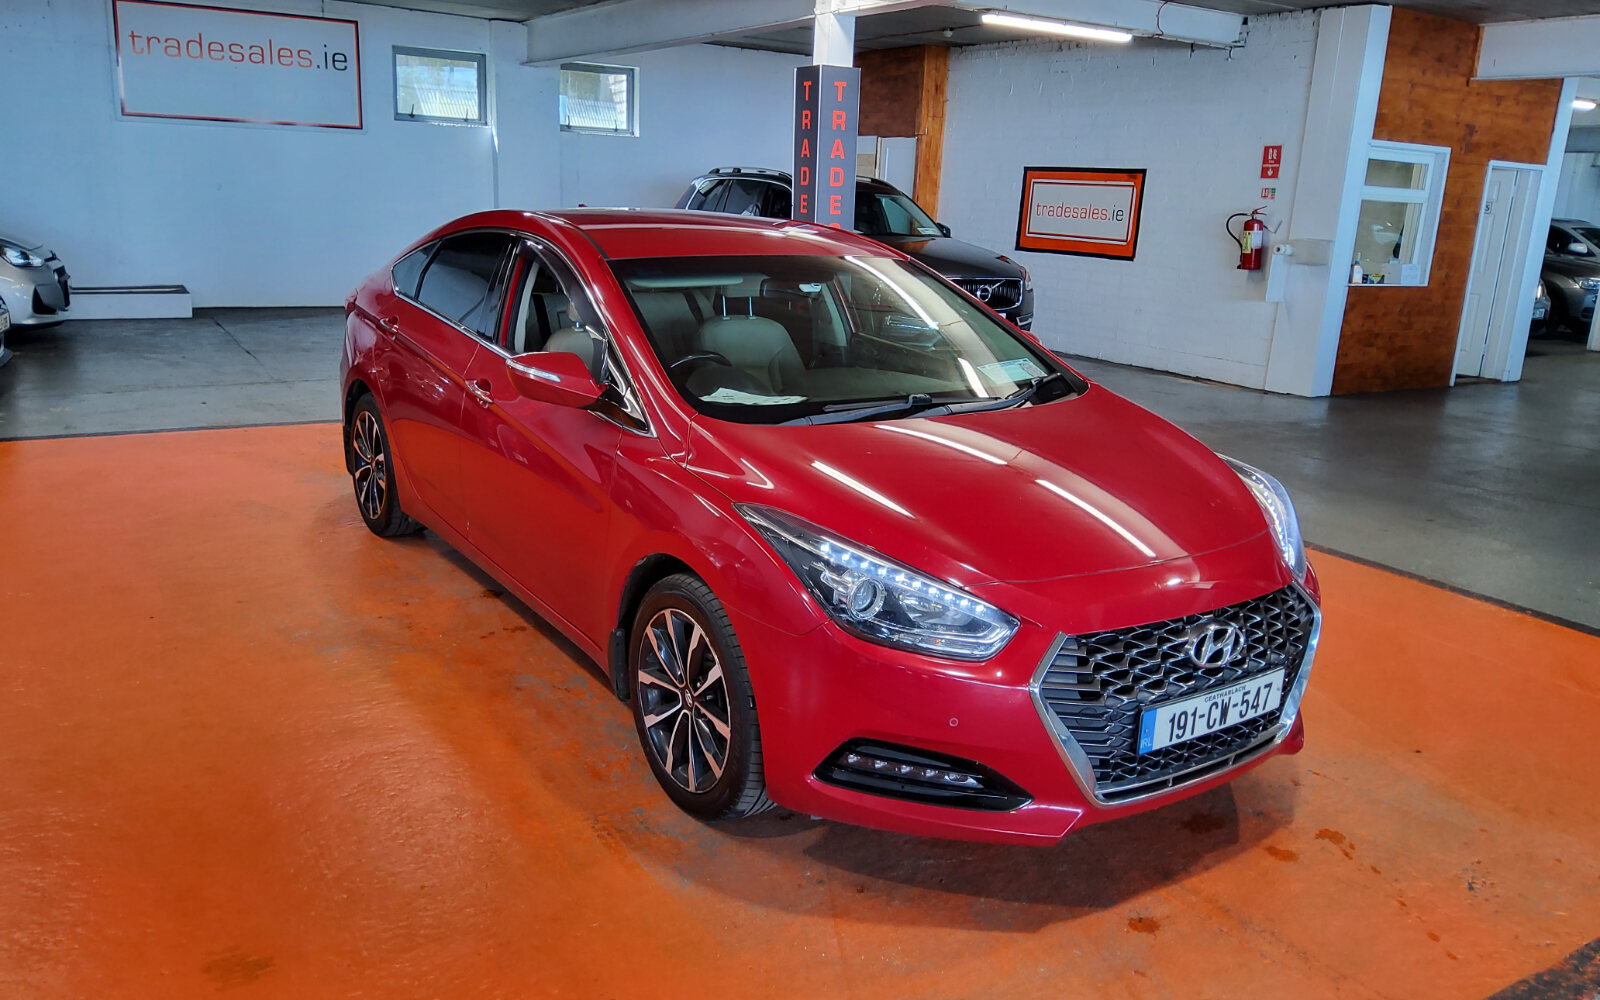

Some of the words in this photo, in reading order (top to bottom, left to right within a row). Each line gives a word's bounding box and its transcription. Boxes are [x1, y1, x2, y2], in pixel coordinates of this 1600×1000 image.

[128, 30, 348, 71] tradesales.ie
[800, 80, 812, 214] TRADE
[1036, 202, 1124, 222] tradesales.ie
[1168, 682, 1273, 743] 191-CW-547
